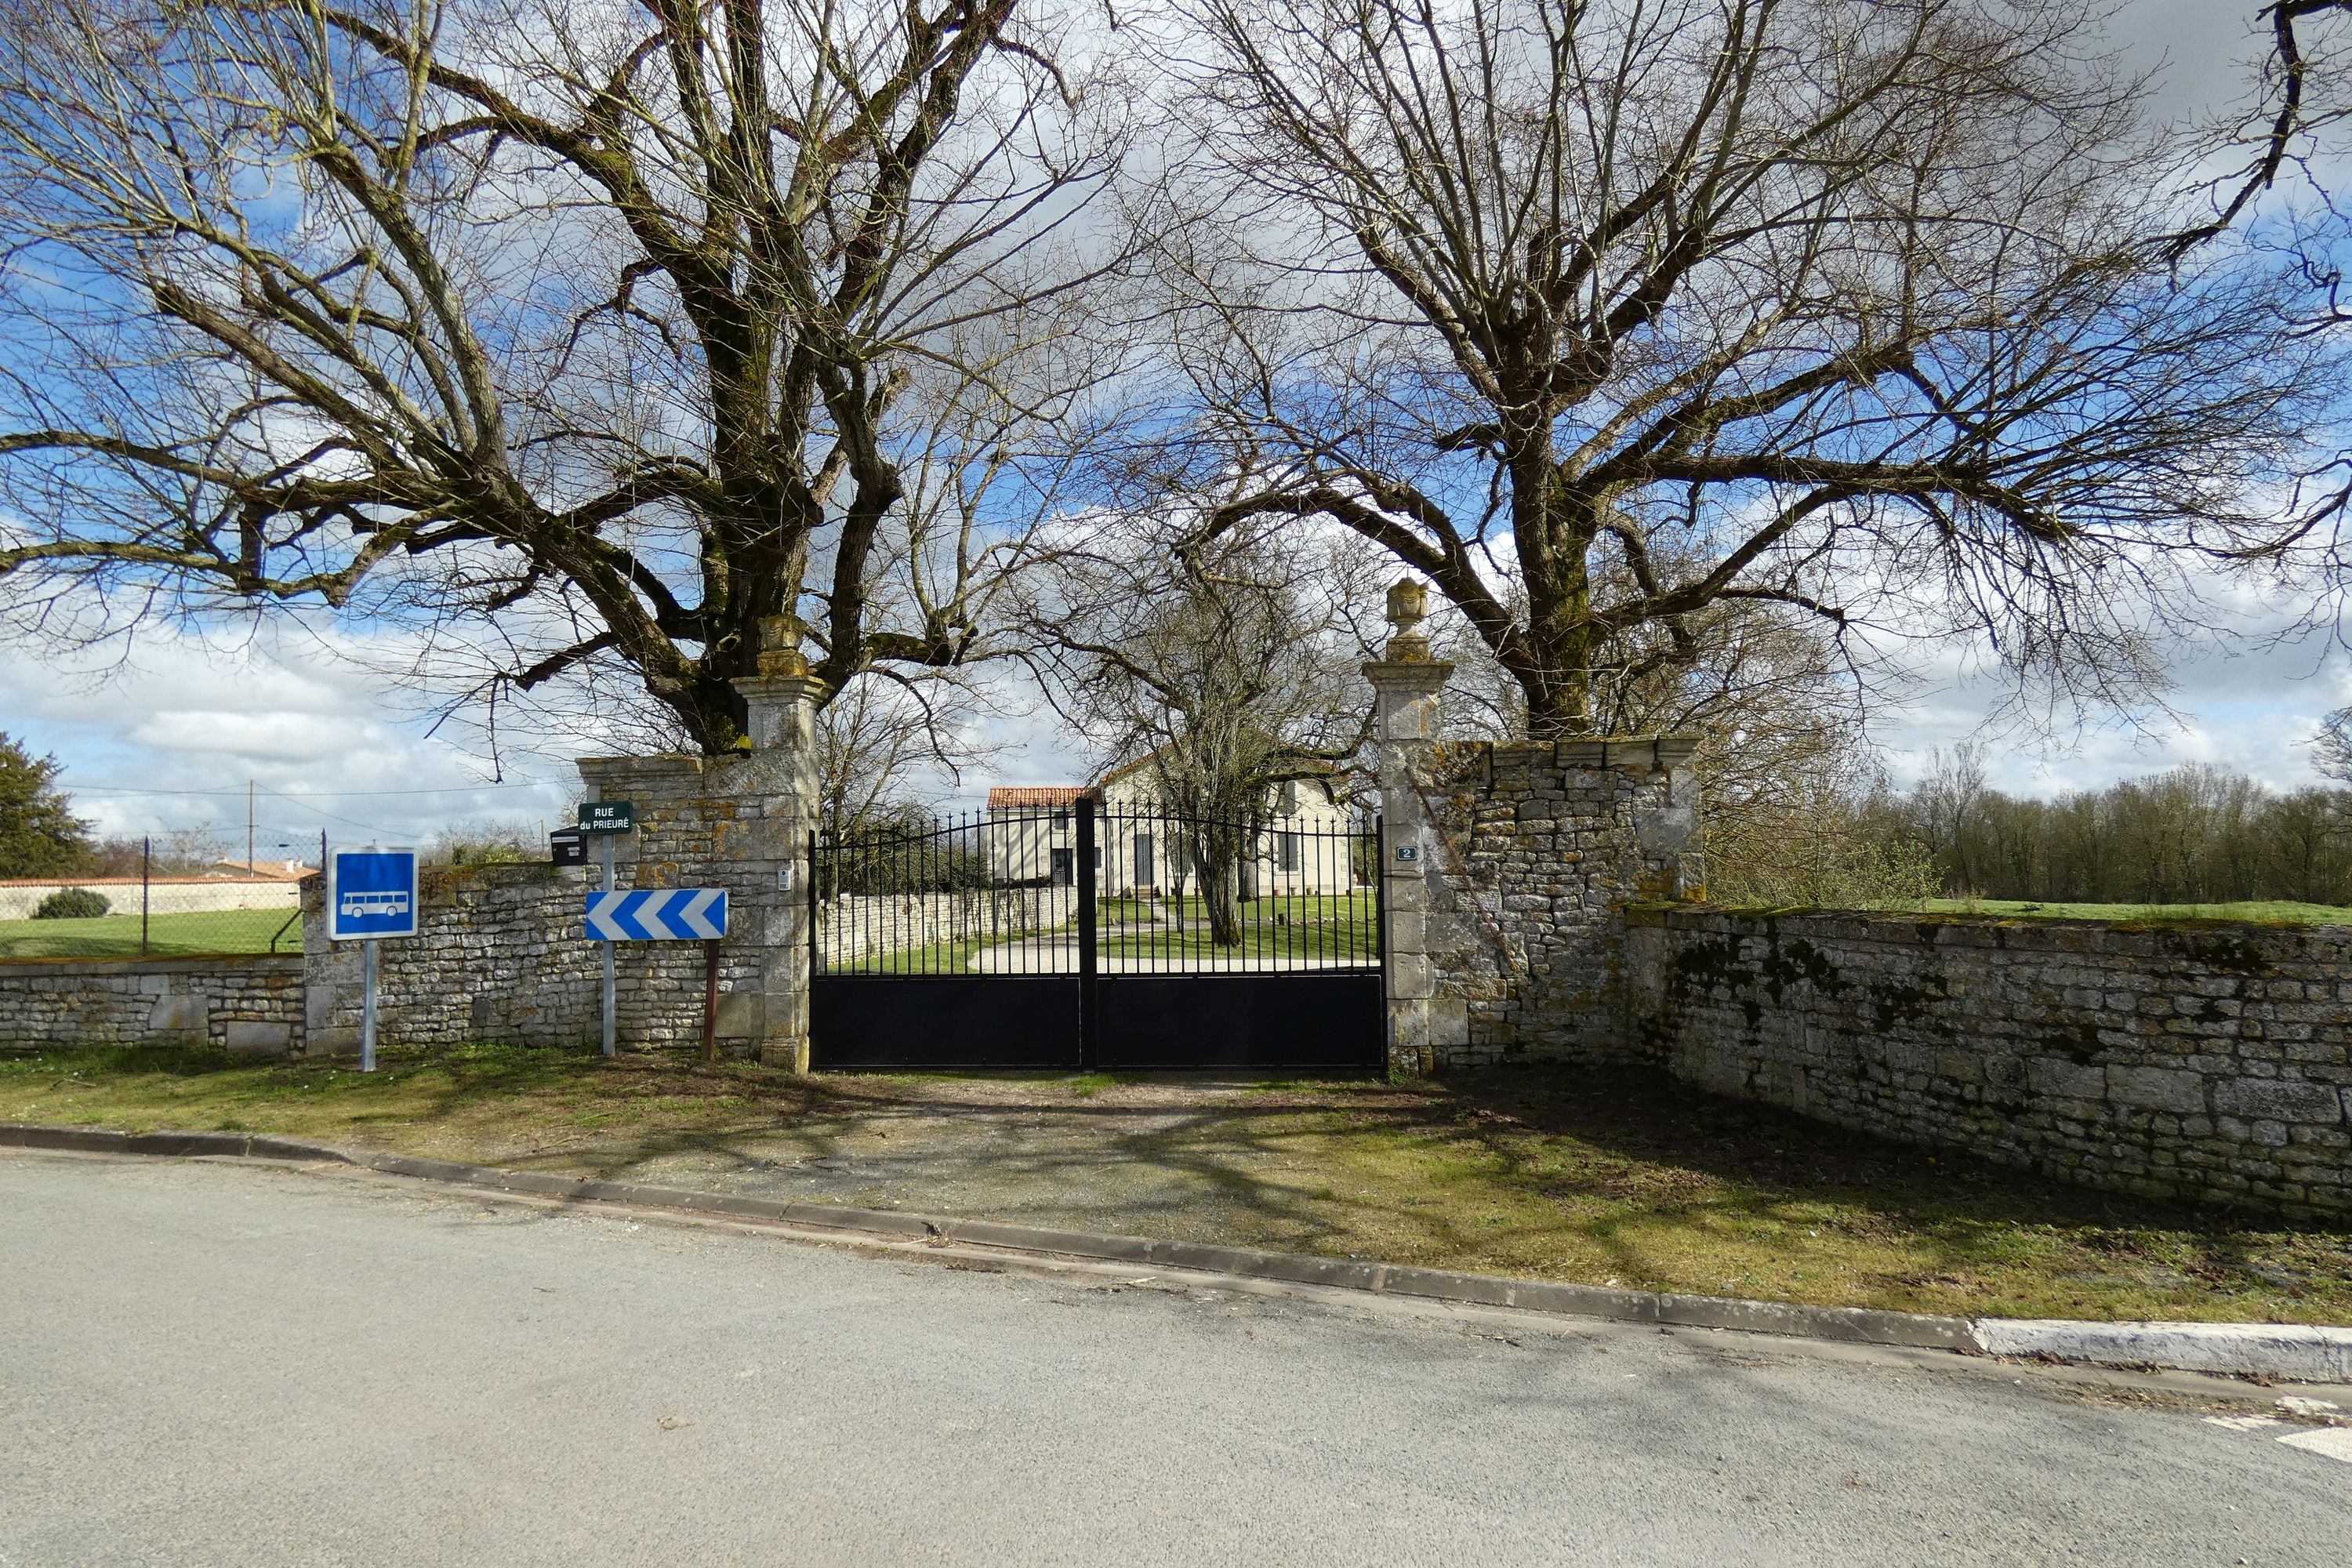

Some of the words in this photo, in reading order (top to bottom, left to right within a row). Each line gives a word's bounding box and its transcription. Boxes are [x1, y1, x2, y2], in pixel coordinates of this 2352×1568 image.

[594, 808, 614, 817] RUE
[580, 821, 590, 829] du
[593, 817, 629, 829] PRIEURÉ
[1403, 848, 1411, 858] 2
